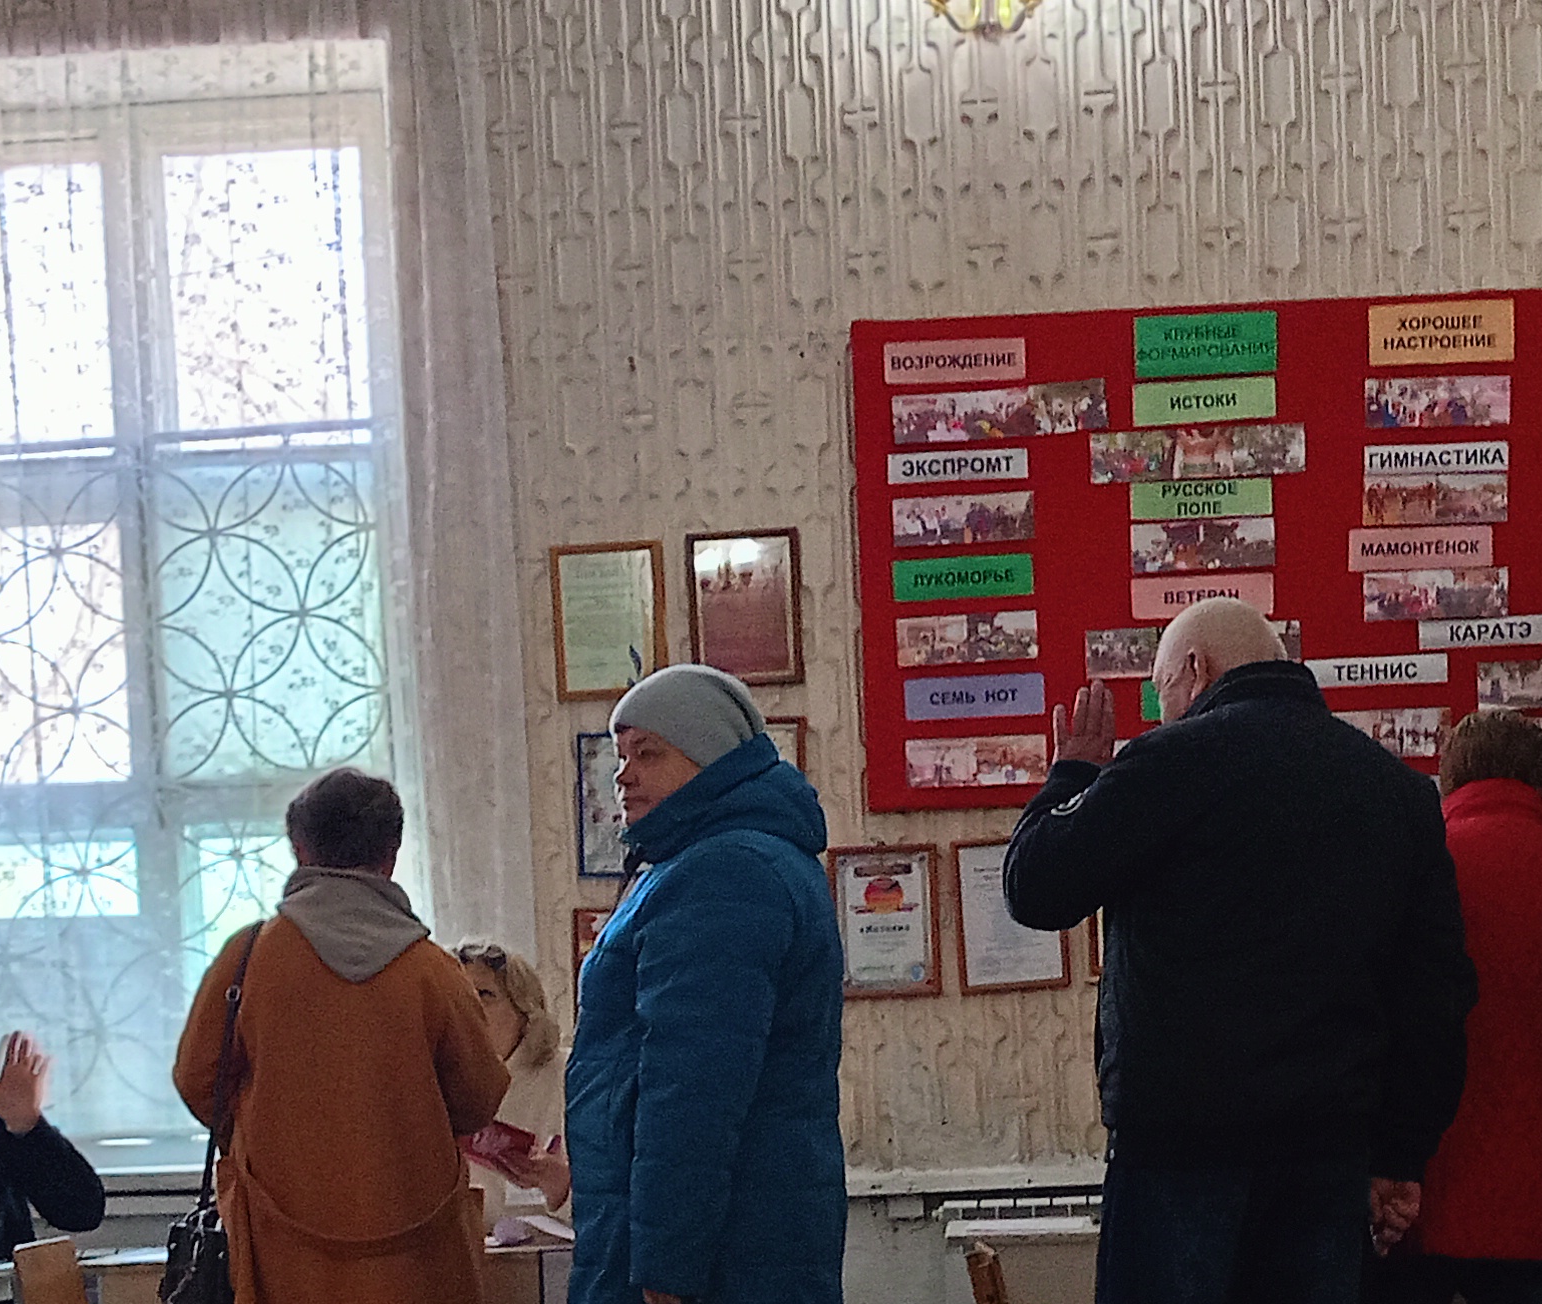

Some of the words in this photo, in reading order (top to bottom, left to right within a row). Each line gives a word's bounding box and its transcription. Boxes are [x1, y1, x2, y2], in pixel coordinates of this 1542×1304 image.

[1397, 314, 1483, 332] ХОРОШЕЕ
[1383, 334, 1497, 351] НАСТРОЕНИЕ
[890, 352, 1017, 371] ВОЗРОЖДЕНИЕ
[1169, 392, 1237, 411] ИСТОКИ
[901, 455, 1014, 477] ЭКСПРОМТ
[1368, 447, 1505, 469] ГИМНАСТИКА
[1161, 481, 1238, 498] РУССКОЕ
[1176, 500, 1222, 516] ПОЛЕ
[913, 568, 1016, 588] ЛУКОМОРЬЕ
[1449, 621, 1532, 642] КАРАТЭ
[1333, 662, 1418, 682] ТЕННИС
[929, 690, 976, 706] СЕМЬ
[985, 688, 1019, 703] НОТ
